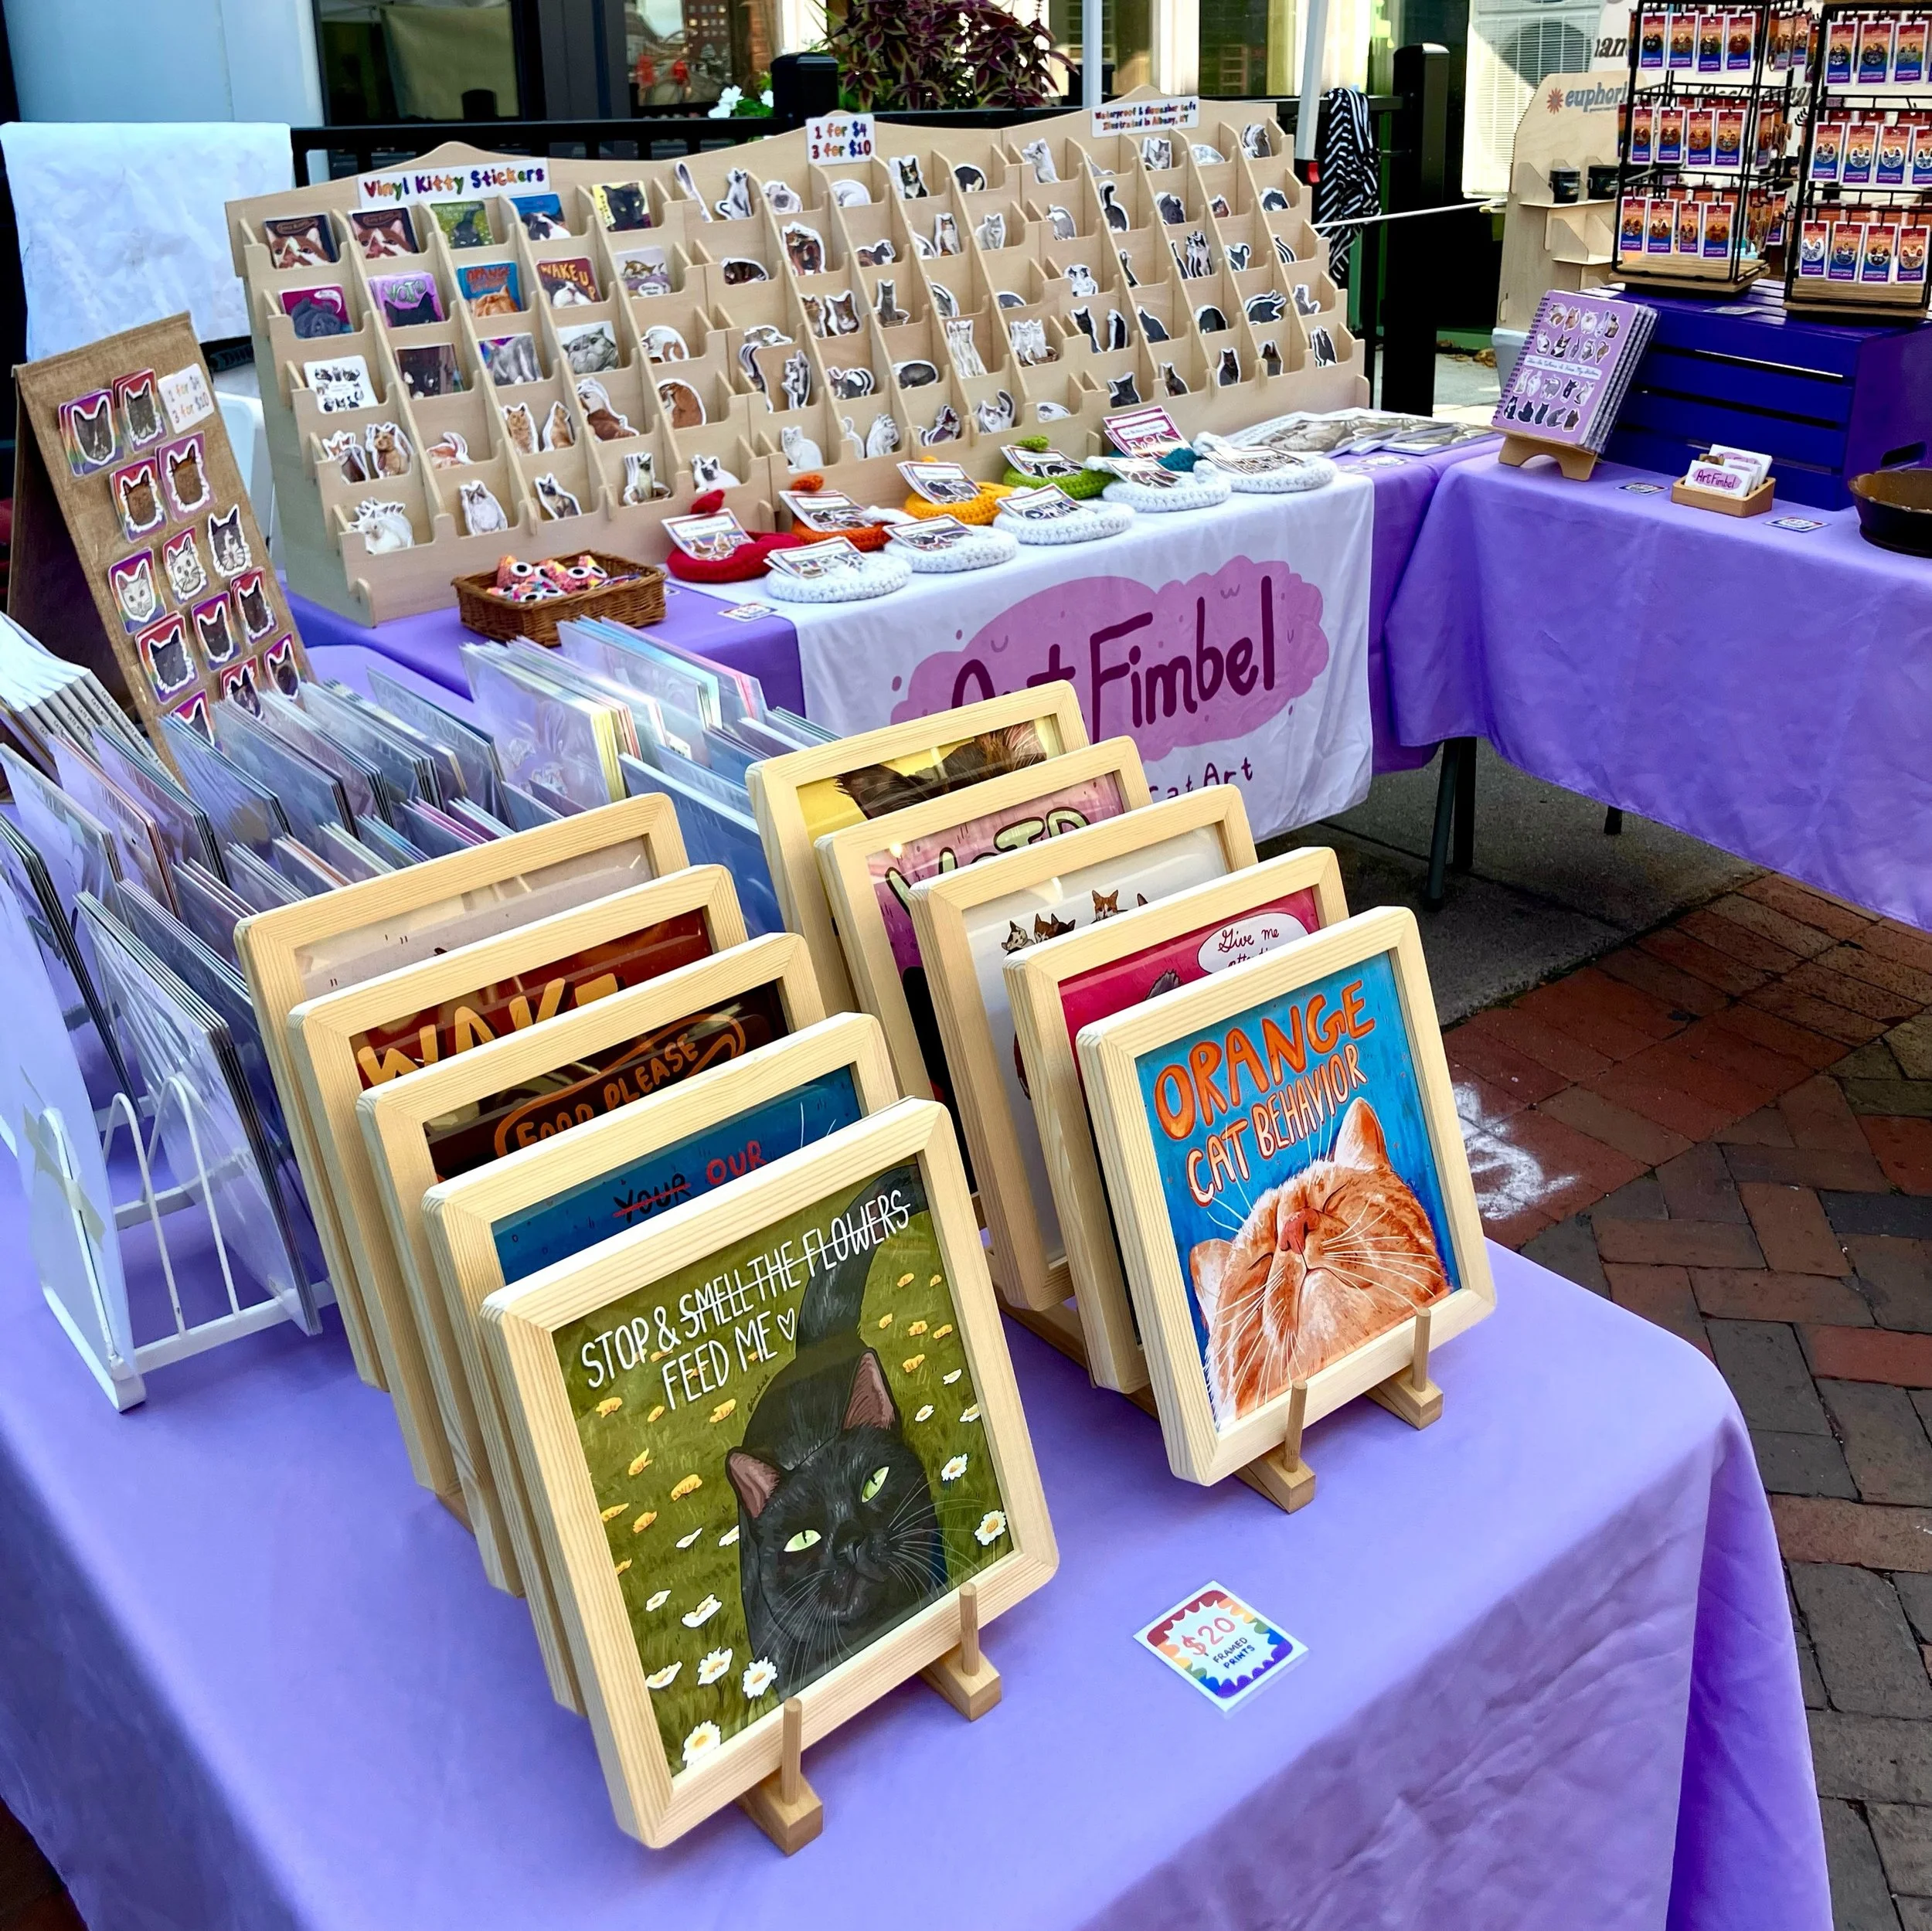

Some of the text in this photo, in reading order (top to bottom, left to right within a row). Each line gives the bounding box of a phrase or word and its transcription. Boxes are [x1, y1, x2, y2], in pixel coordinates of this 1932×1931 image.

[815, 121, 866, 140] 1 for $4
[811, 139, 871, 159] 3 for $10
[363, 167, 545, 202] Vinyl Kitty Stickers
[540, 263, 579, 282] WAKE
[195, 392, 209, 411] $10
[1203, 756, 1253, 787] Art
[1218, 927, 1280, 953] Give me
[604, 1033, 699, 1112] PLEASE
[1155, 979, 1376, 1141] ORANGE
[1186, 1118, 1250, 1207] CAT
[1250, 1043, 1368, 1160] BEHAVIOR
[612, 1140, 767, 1224] YOUR OUR
[580, 1188, 912, 1389] STOP & SMELL THE FLOWERS
[661, 1311, 777, 1410] FEED ME
[1181, 1617, 1236, 1657] $20
[1213, 1637, 1248, 1663] FRAMED
[1223, 1644, 1256, 1669] PRINTS
